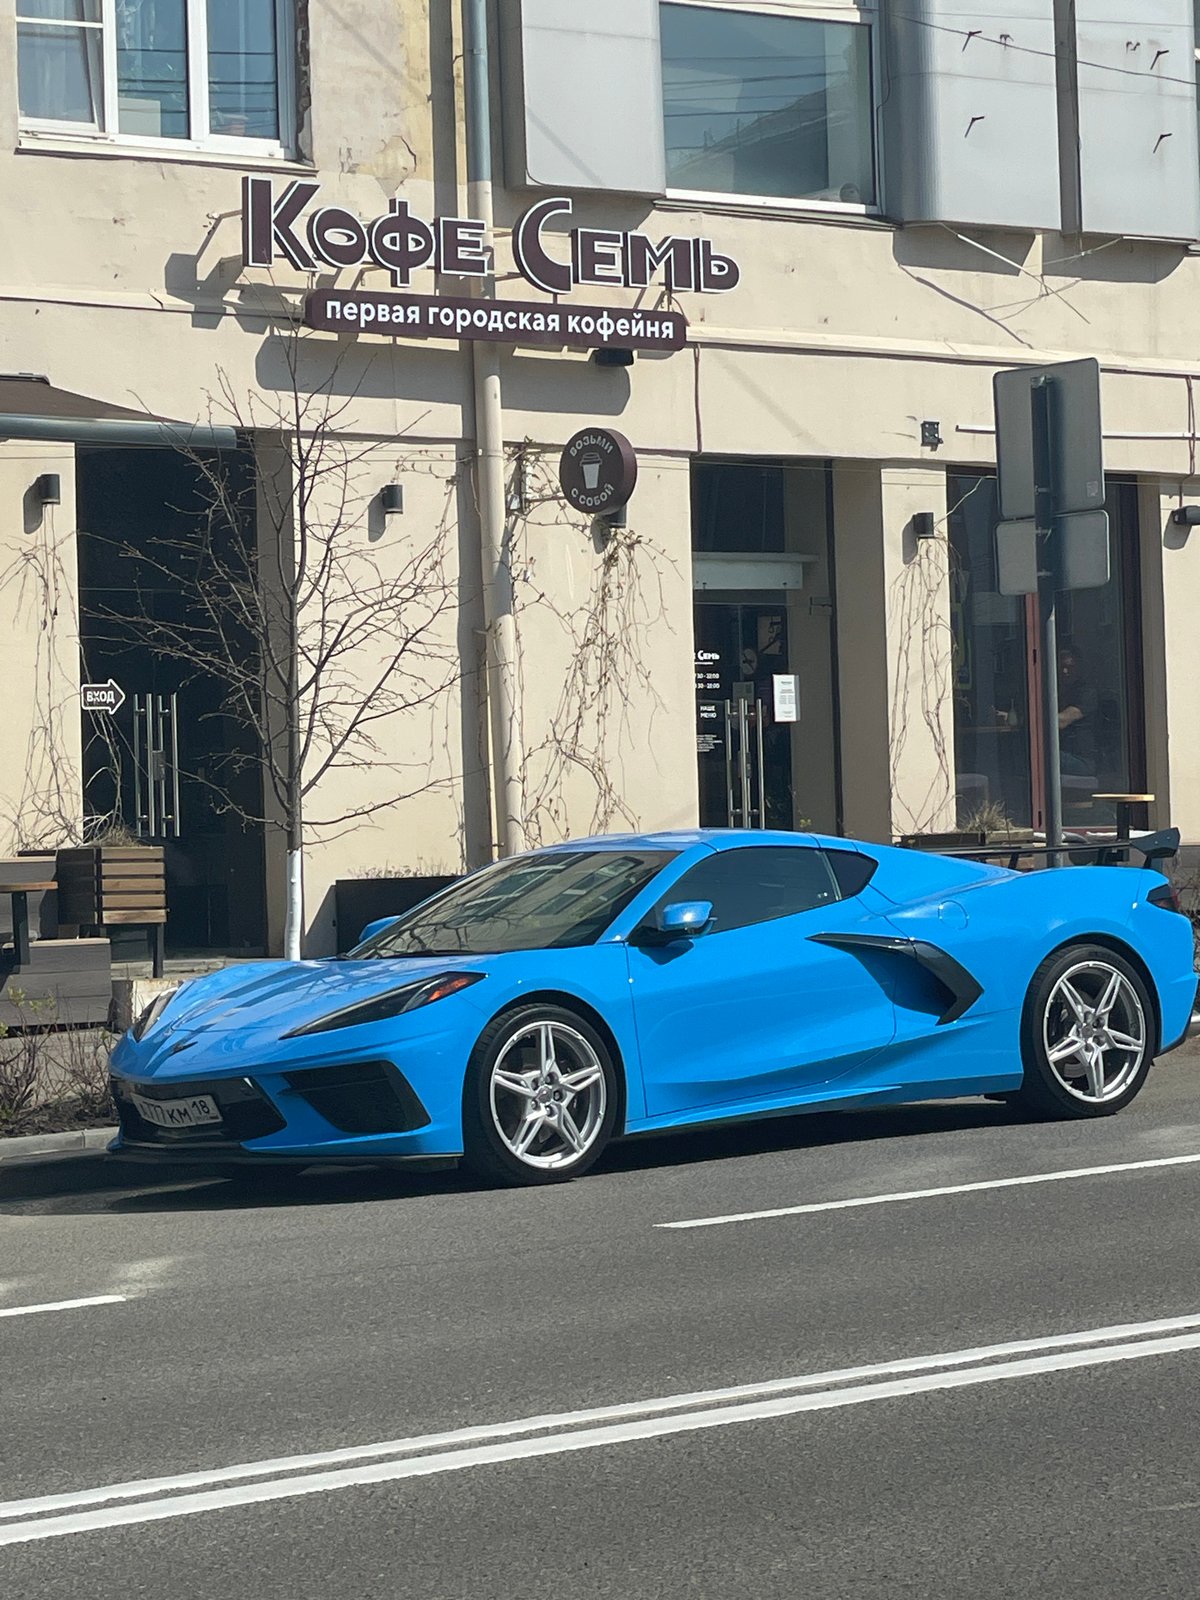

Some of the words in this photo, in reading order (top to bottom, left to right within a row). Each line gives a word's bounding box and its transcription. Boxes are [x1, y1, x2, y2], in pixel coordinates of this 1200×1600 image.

[242, 175, 488, 288] КОФЕ
[512, 197, 741, 294] СЕМЬ
[325, 300, 420, 328] первая
[428, 306, 560, 334] городская
[567, 311, 674, 341] кофейня
[569, 435, 613, 457] ВОЗЬМИ
[579, 483, 615, 506] СОБОЙ
[86, 690, 115, 704] ВХОД
